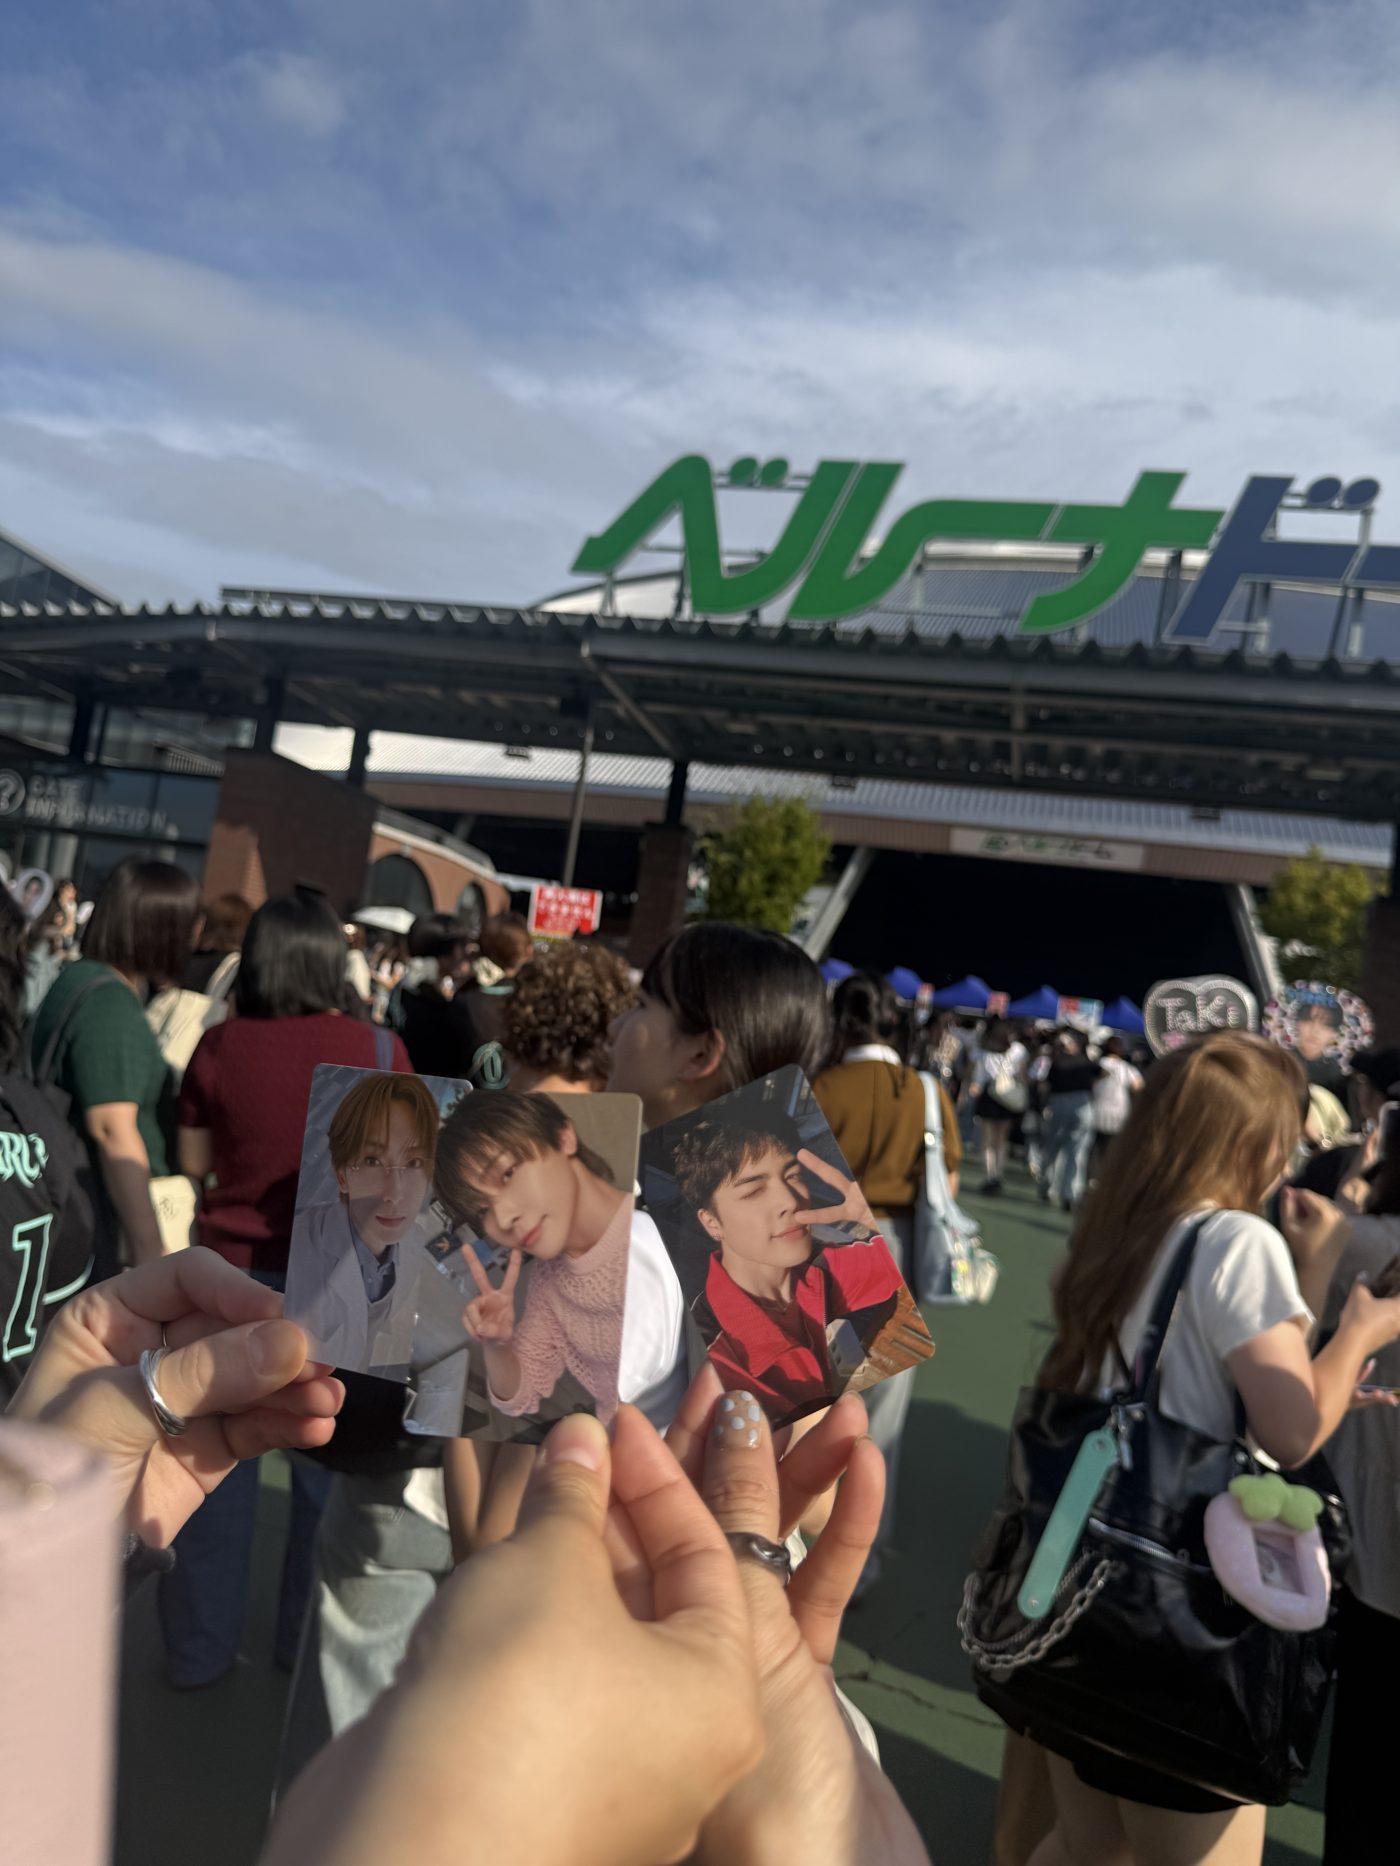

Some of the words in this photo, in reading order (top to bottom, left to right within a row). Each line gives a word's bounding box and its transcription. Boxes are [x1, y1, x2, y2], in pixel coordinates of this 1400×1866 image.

[571, 453, 1400, 647] ベルーナド
